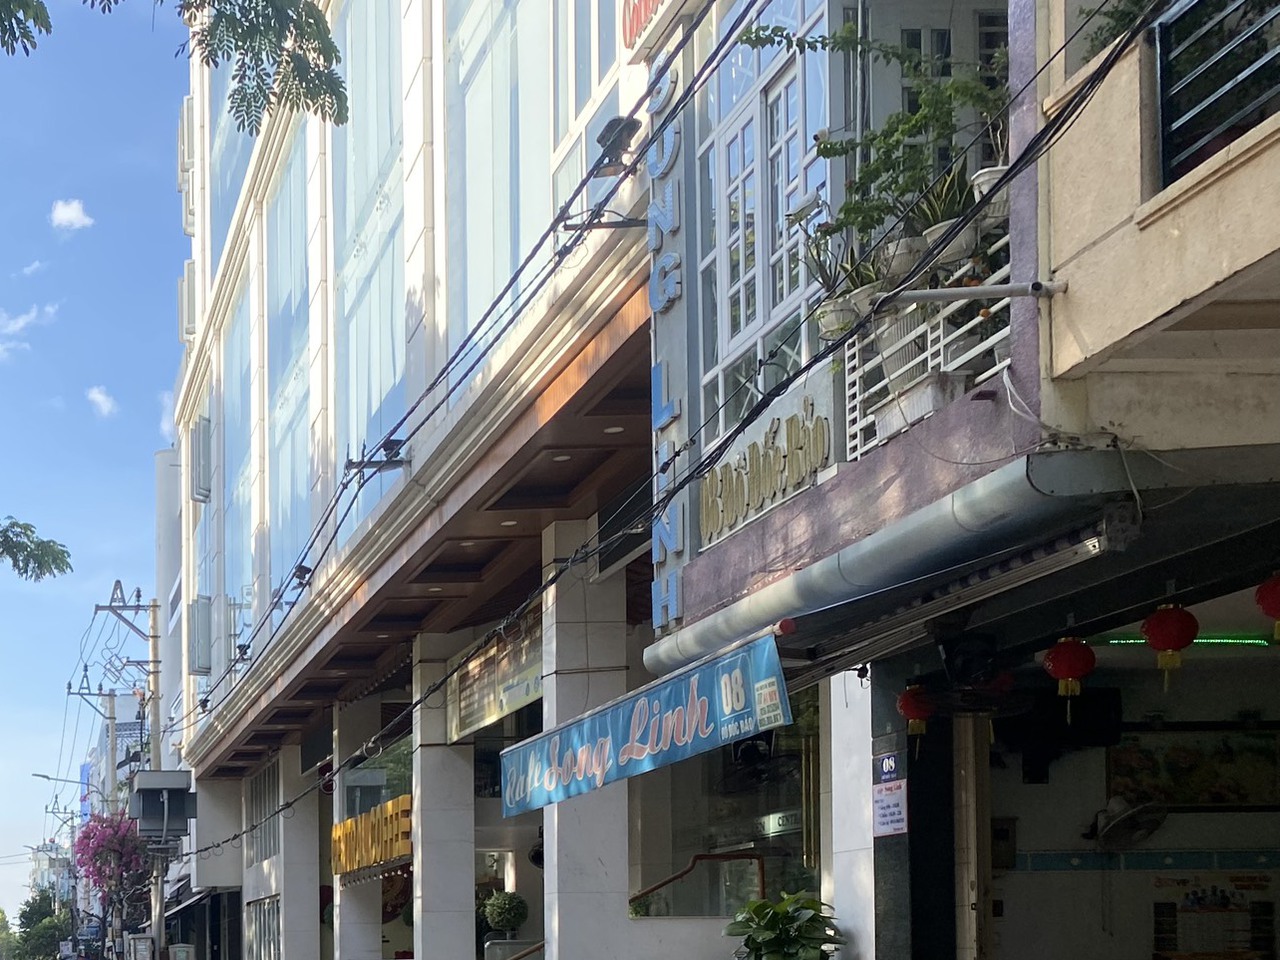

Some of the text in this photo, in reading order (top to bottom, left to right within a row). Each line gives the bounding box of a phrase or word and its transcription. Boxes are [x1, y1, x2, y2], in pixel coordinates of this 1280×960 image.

[651, 360, 682, 630] LINH
[721, 668, 746, 715] 08
[544, 735, 613, 788] Song
[618, 673, 714, 766] Linh
[882, 756, 895, 773] 08
[369, 794, 411, 864] COFFEE
